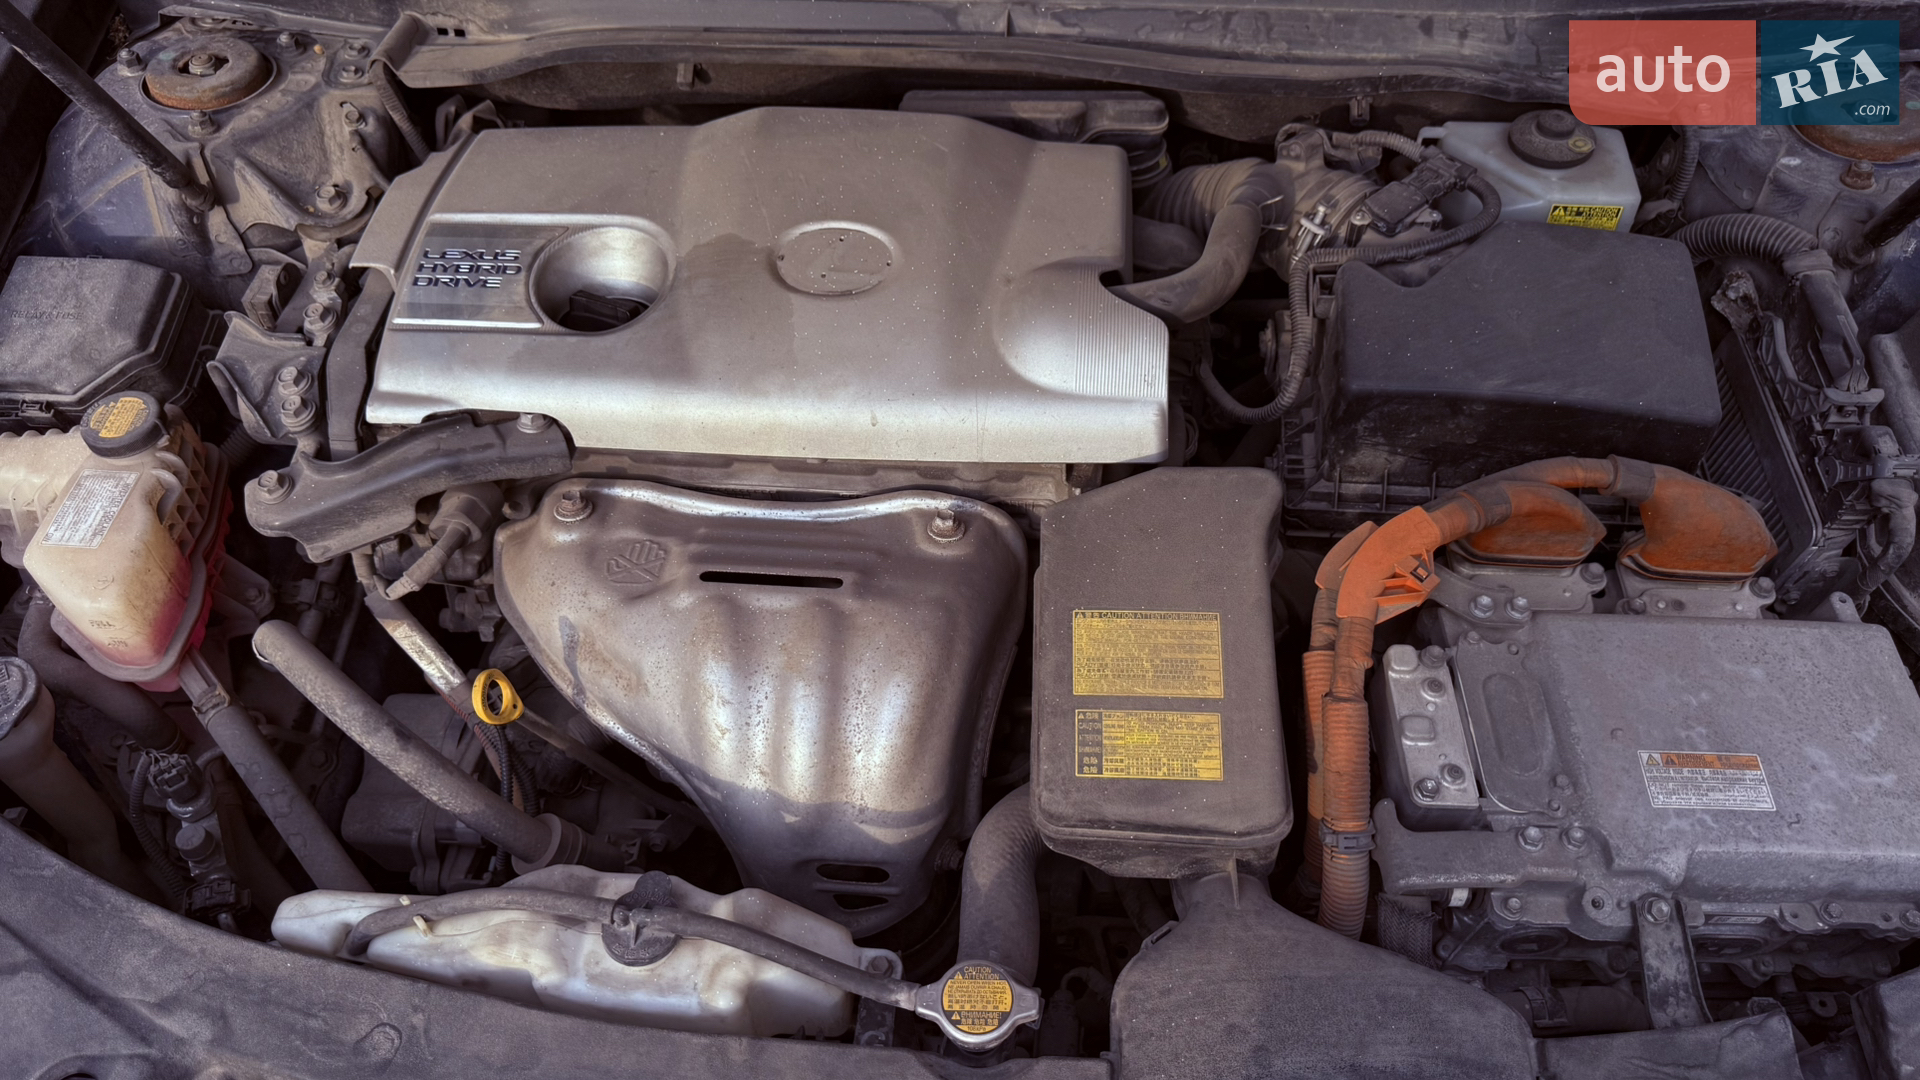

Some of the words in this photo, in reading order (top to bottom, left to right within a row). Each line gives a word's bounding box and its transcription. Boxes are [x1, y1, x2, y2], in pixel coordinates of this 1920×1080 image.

[423, 248, 521, 261] LEXUS
[417, 261, 523, 275] HYBRID
[412, 274, 503, 288] DRIVE
[1136, 612, 1178, 620] ATTENTION
[961, 1011, 1002, 1019] ВНИМАНИЕ!
